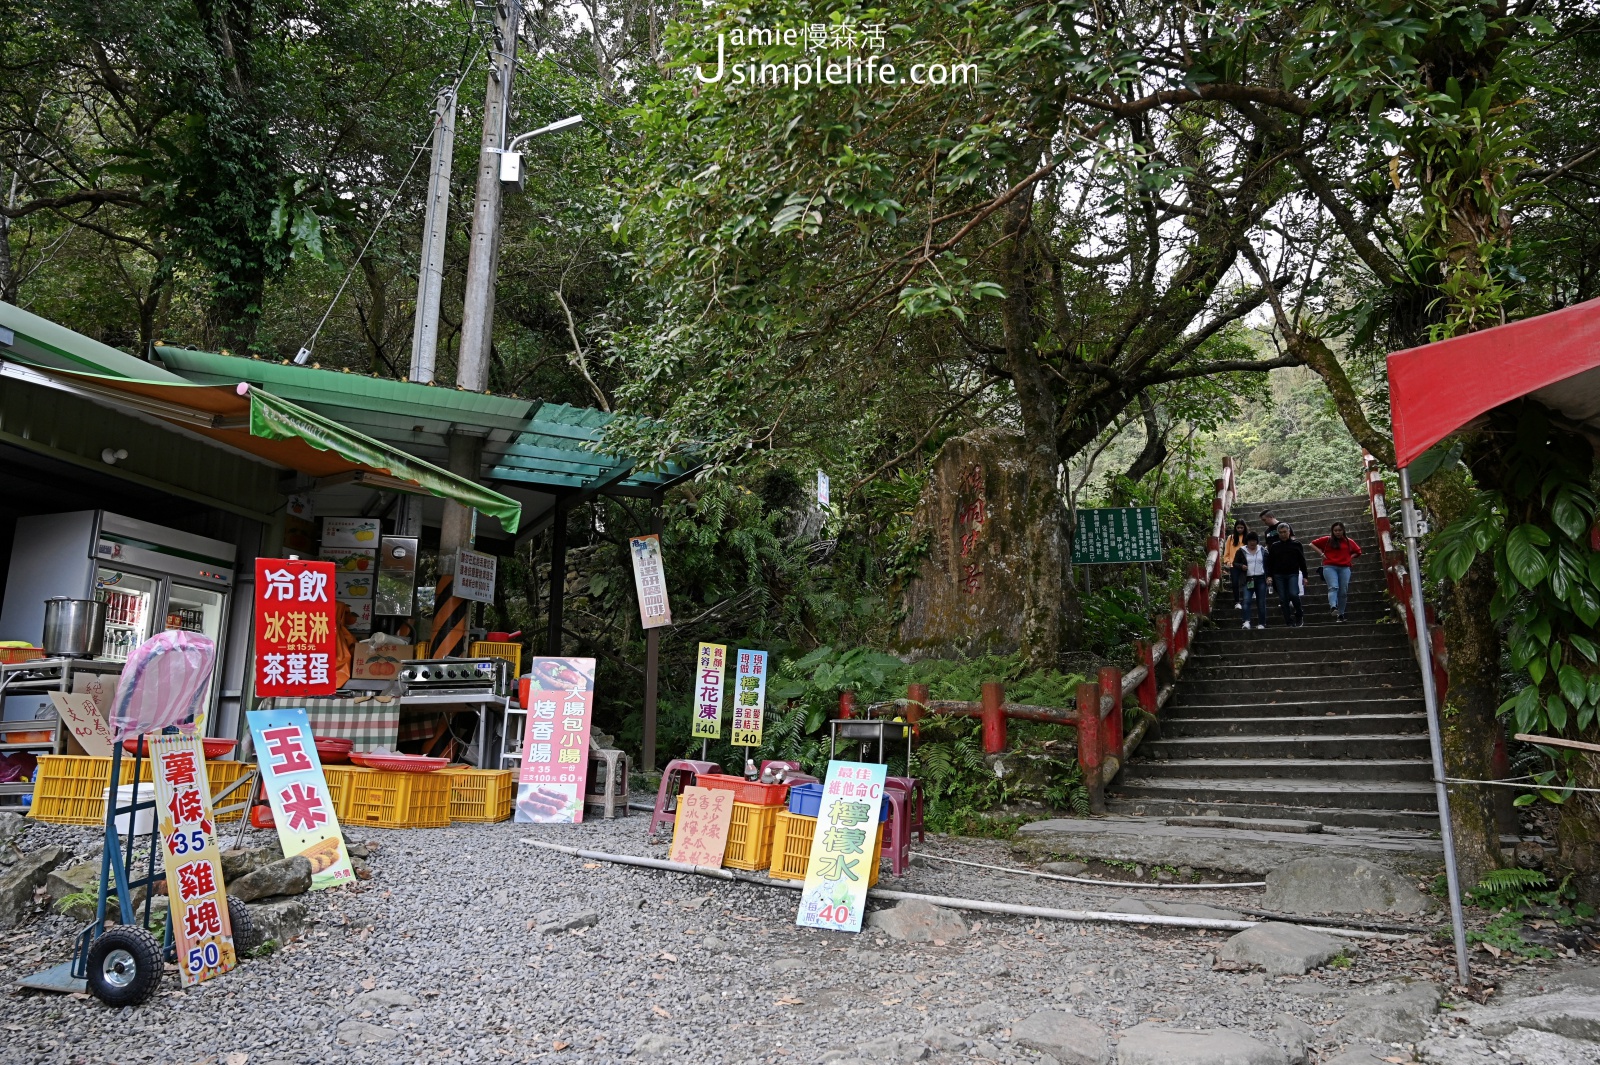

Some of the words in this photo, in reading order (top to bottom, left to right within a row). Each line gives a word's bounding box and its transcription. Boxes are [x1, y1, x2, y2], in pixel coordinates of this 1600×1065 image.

[264, 569, 327, 602] 冷飲
[264, 611, 329, 643] 冰淇淋
[263, 653, 329, 686] 茶葉蛋
[701, 646, 711, 667] 美容
[698, 668, 720, 720] 石花凍
[739, 676, 761, 707] 檸檬
[528, 699, 557, 764] 烤香腸
[558, 686, 586, 764] 大腸包小腸
[161, 751, 203, 826] 薯條
[263, 727, 327, 832] 玉米
[838, 766, 872, 780] 最佳
[686, 793, 725, 812] 百香果
[828, 780, 880, 799] 維他命C
[683, 821, 720, 840] 檸檬
[685, 809, 719, 824] 冰沙
[682, 836, 706, 850] 冬瓜
[816, 800, 871, 882] 檸檬水
[177, 860, 222, 939] 雞塊
